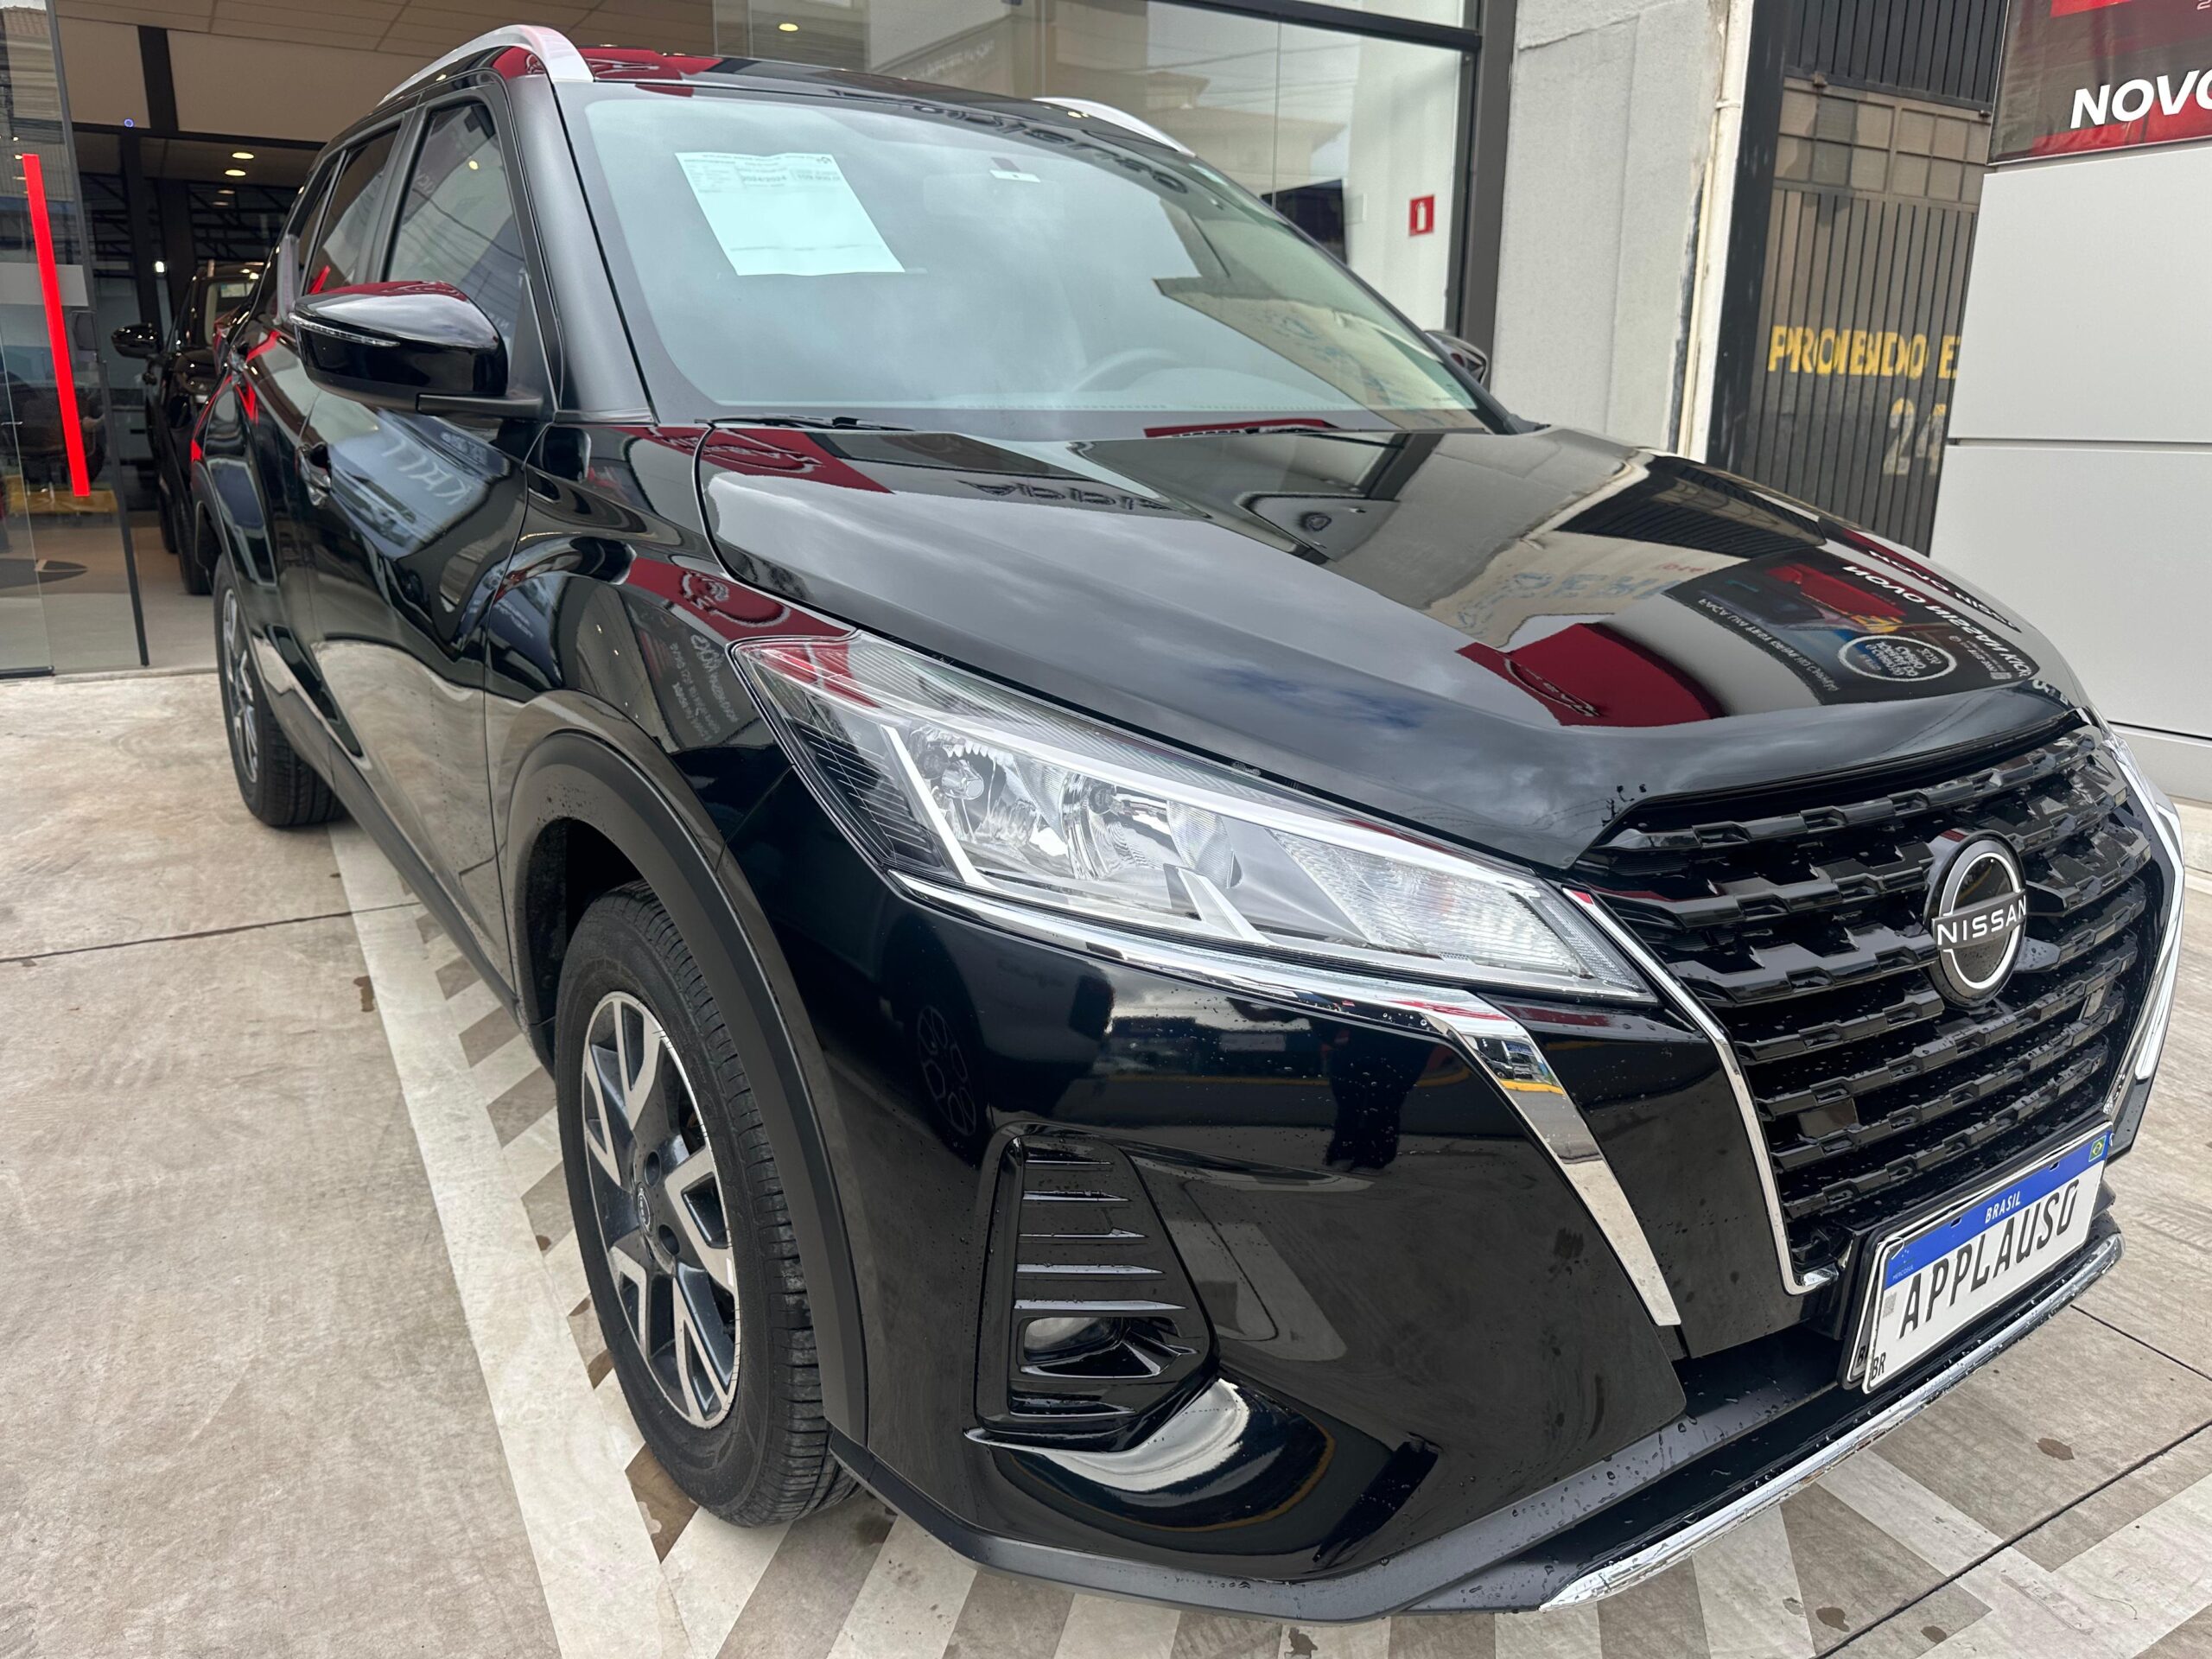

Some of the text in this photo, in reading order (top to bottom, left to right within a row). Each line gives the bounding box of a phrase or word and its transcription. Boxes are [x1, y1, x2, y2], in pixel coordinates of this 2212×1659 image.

[1768, 325, 1929, 380] PROIBIDO
[1937, 895, 2026, 945] NISSAN
[1985, 1192, 2021, 1224] BRASIL
[1898, 1179, 2080, 1339] APPLAUSO
[1871, 1351, 1887, 1381] BR
